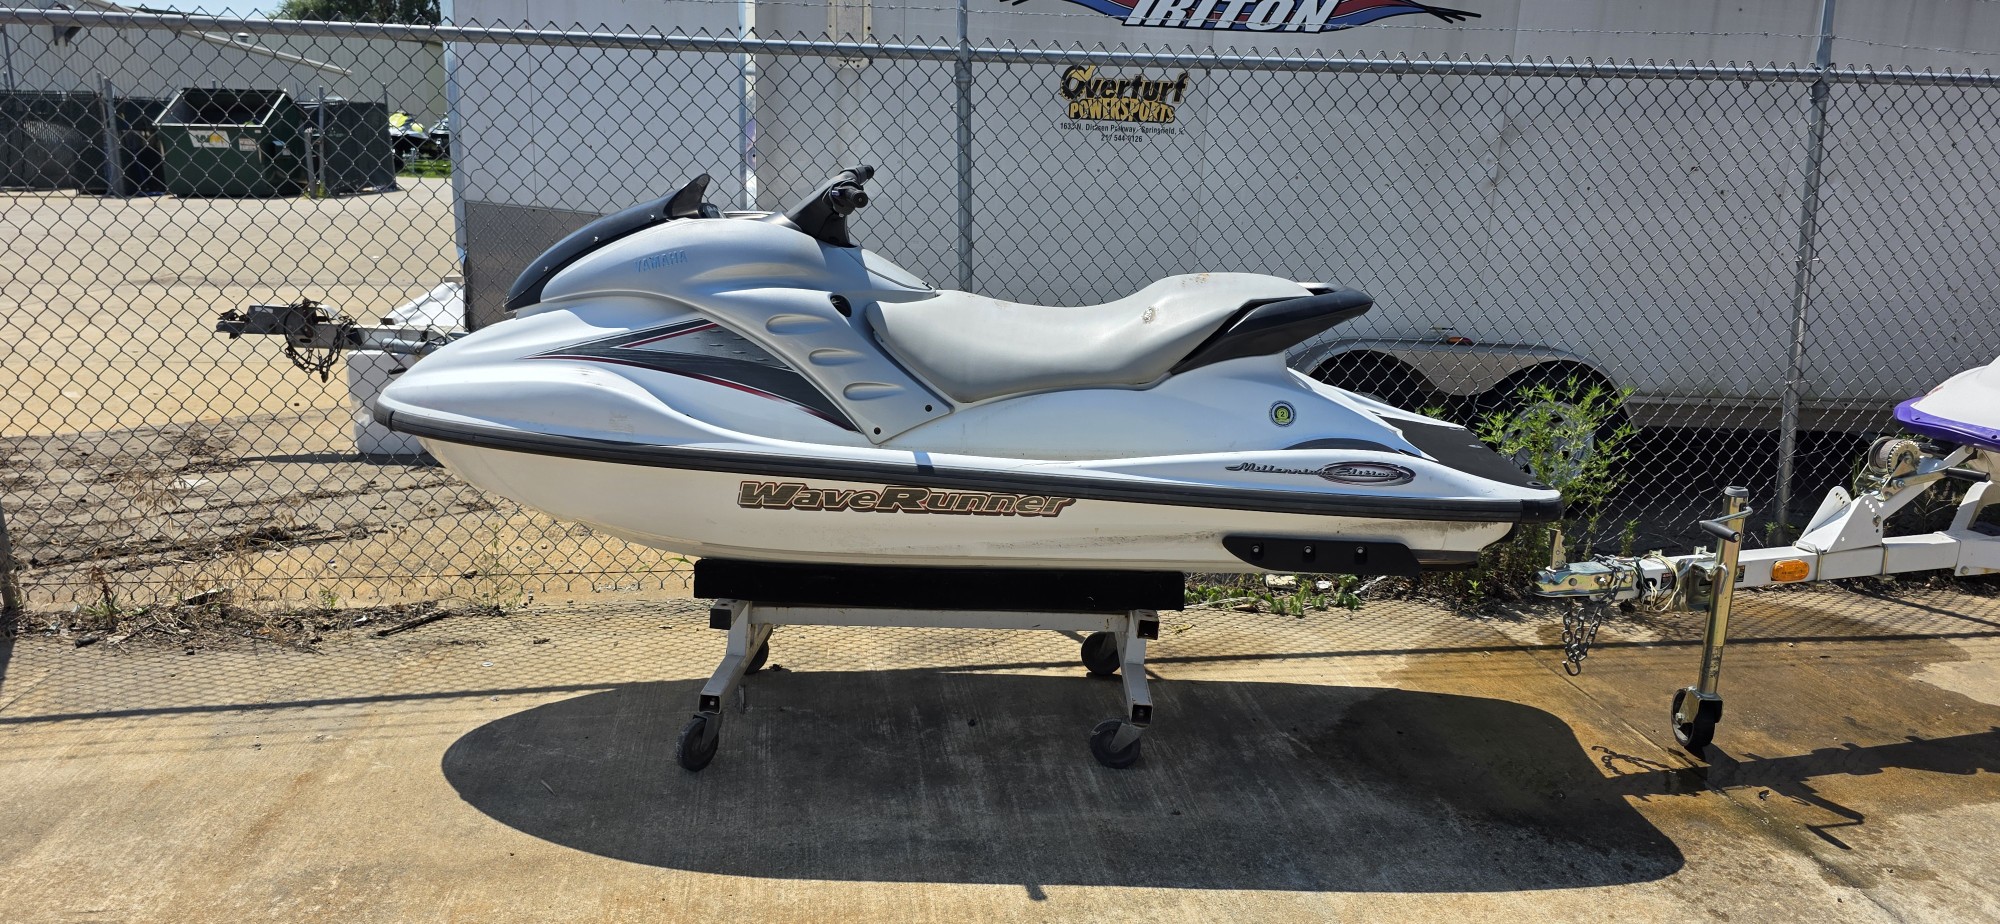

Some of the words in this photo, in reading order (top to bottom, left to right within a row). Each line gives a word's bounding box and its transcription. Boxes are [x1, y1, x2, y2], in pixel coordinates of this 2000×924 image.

[1060, 64, 1190, 103] Overturf
[1069, 97, 1175, 123] POWERSPORTS
[633, 249, 688, 272] YAMAHA
[1334, 466, 1399, 479] Edition
[738, 481, 1076, 517] WaveRunner
